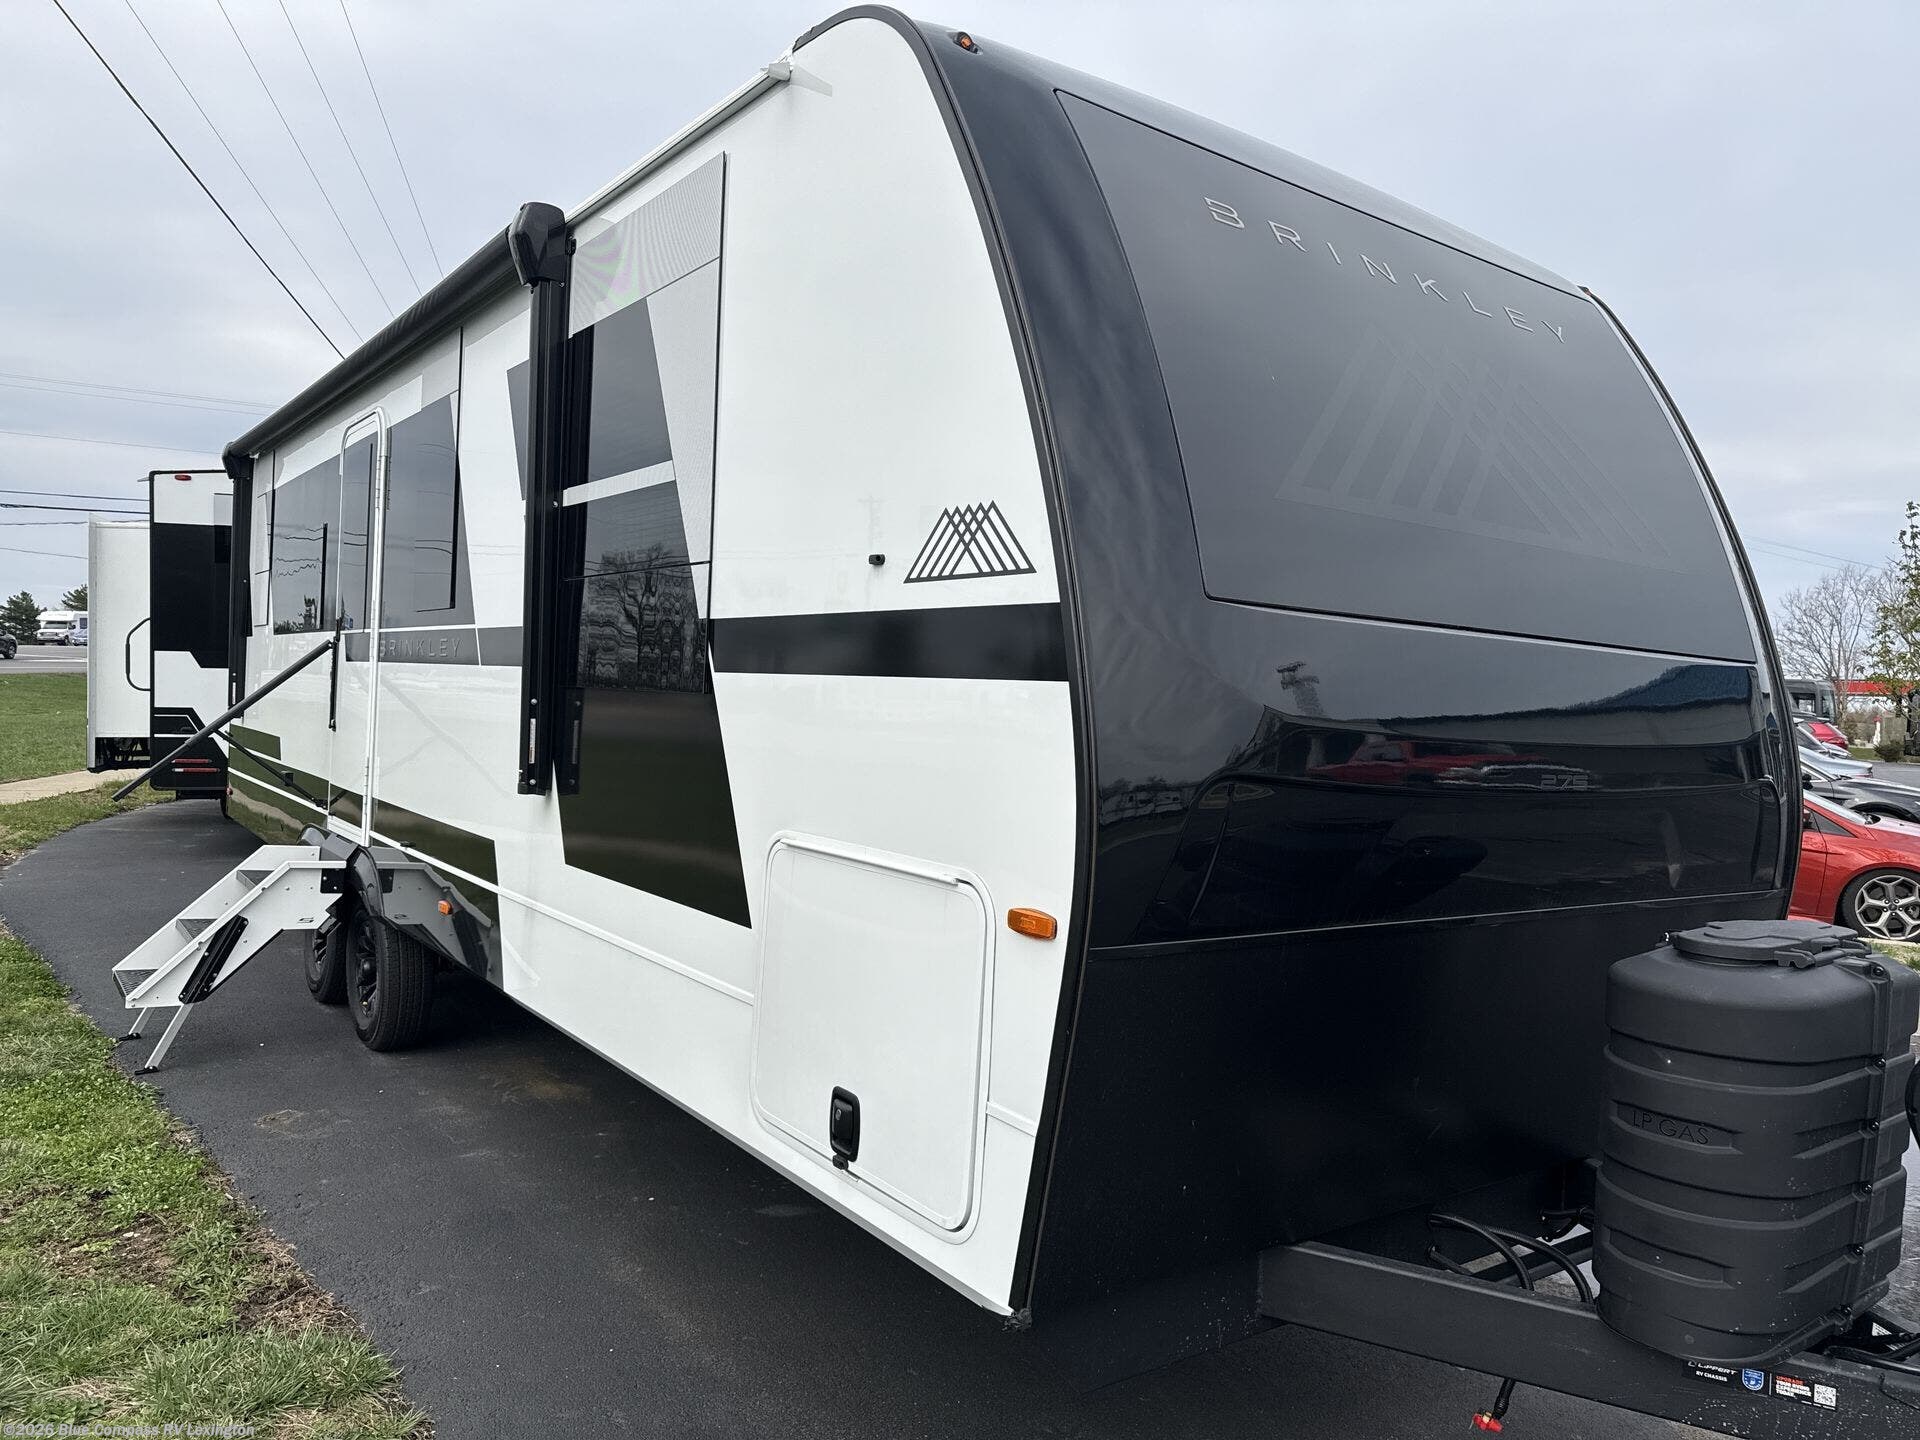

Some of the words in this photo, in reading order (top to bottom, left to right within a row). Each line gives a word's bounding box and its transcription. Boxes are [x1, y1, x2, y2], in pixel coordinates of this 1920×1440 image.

[1203, 196, 1565, 344] BRINKLEY
[380, 638, 463, 657] BRINKLEY
[1632, 1110, 1653, 1128] LP
[1659, 1119, 1709, 1145] GAS
[1704, 1372, 1728, 1382] CHASSIS
